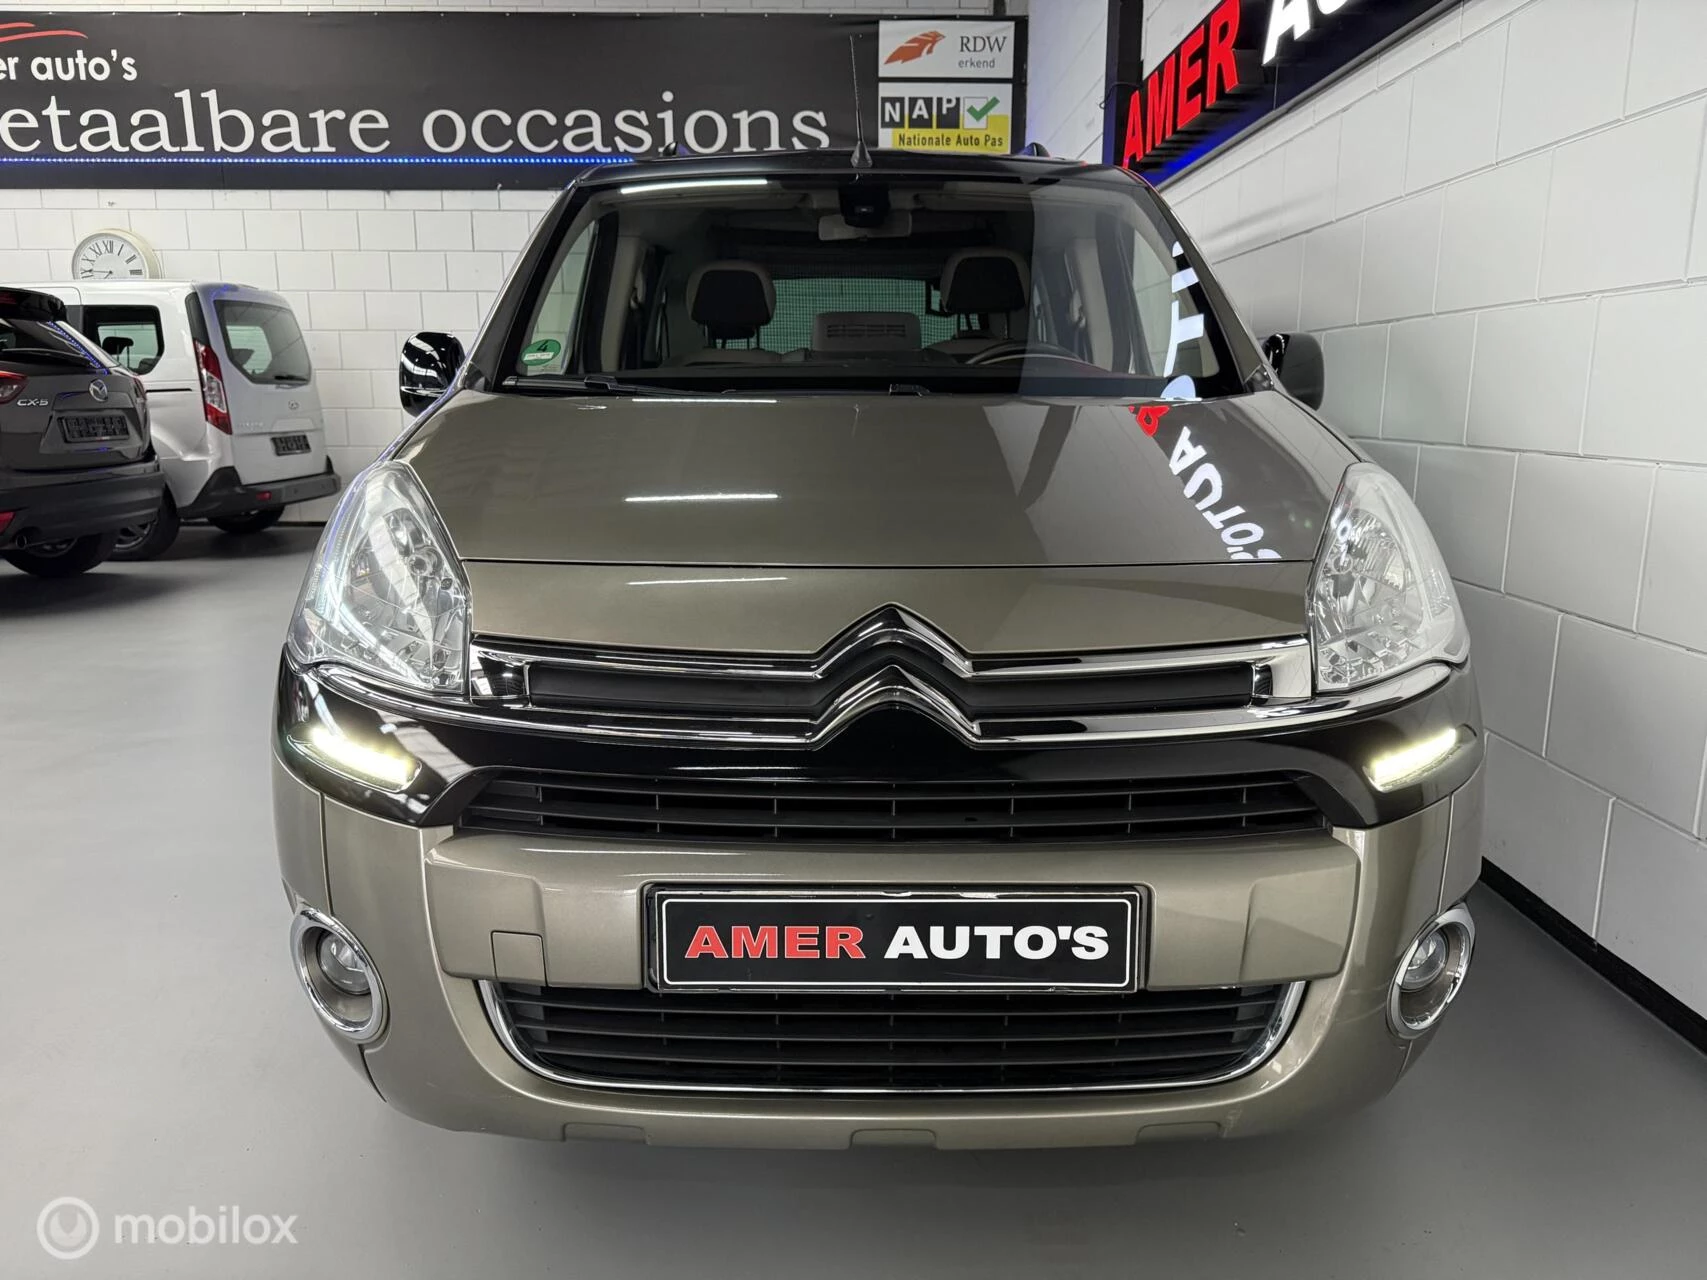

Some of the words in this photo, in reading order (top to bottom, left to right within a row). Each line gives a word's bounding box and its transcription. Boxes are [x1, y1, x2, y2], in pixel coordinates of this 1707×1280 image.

[959, 36, 1007, 53] RDW
[958, 58, 995, 69] erkend
[1122, 0, 1241, 169] AMER
[1262, 0, 1349, 66] A
[884, 97, 957, 123] NAP
[422, 91, 830, 154] occasions
[898, 133, 951, 146] Nationale
[956, 134, 980, 147] Auto
[984, 135, 1003, 147] Pas
[16, 398, 49, 406] CX-5
[684, 925, 867, 959] AMER
[884, 925, 1110, 961] AUTO'S
